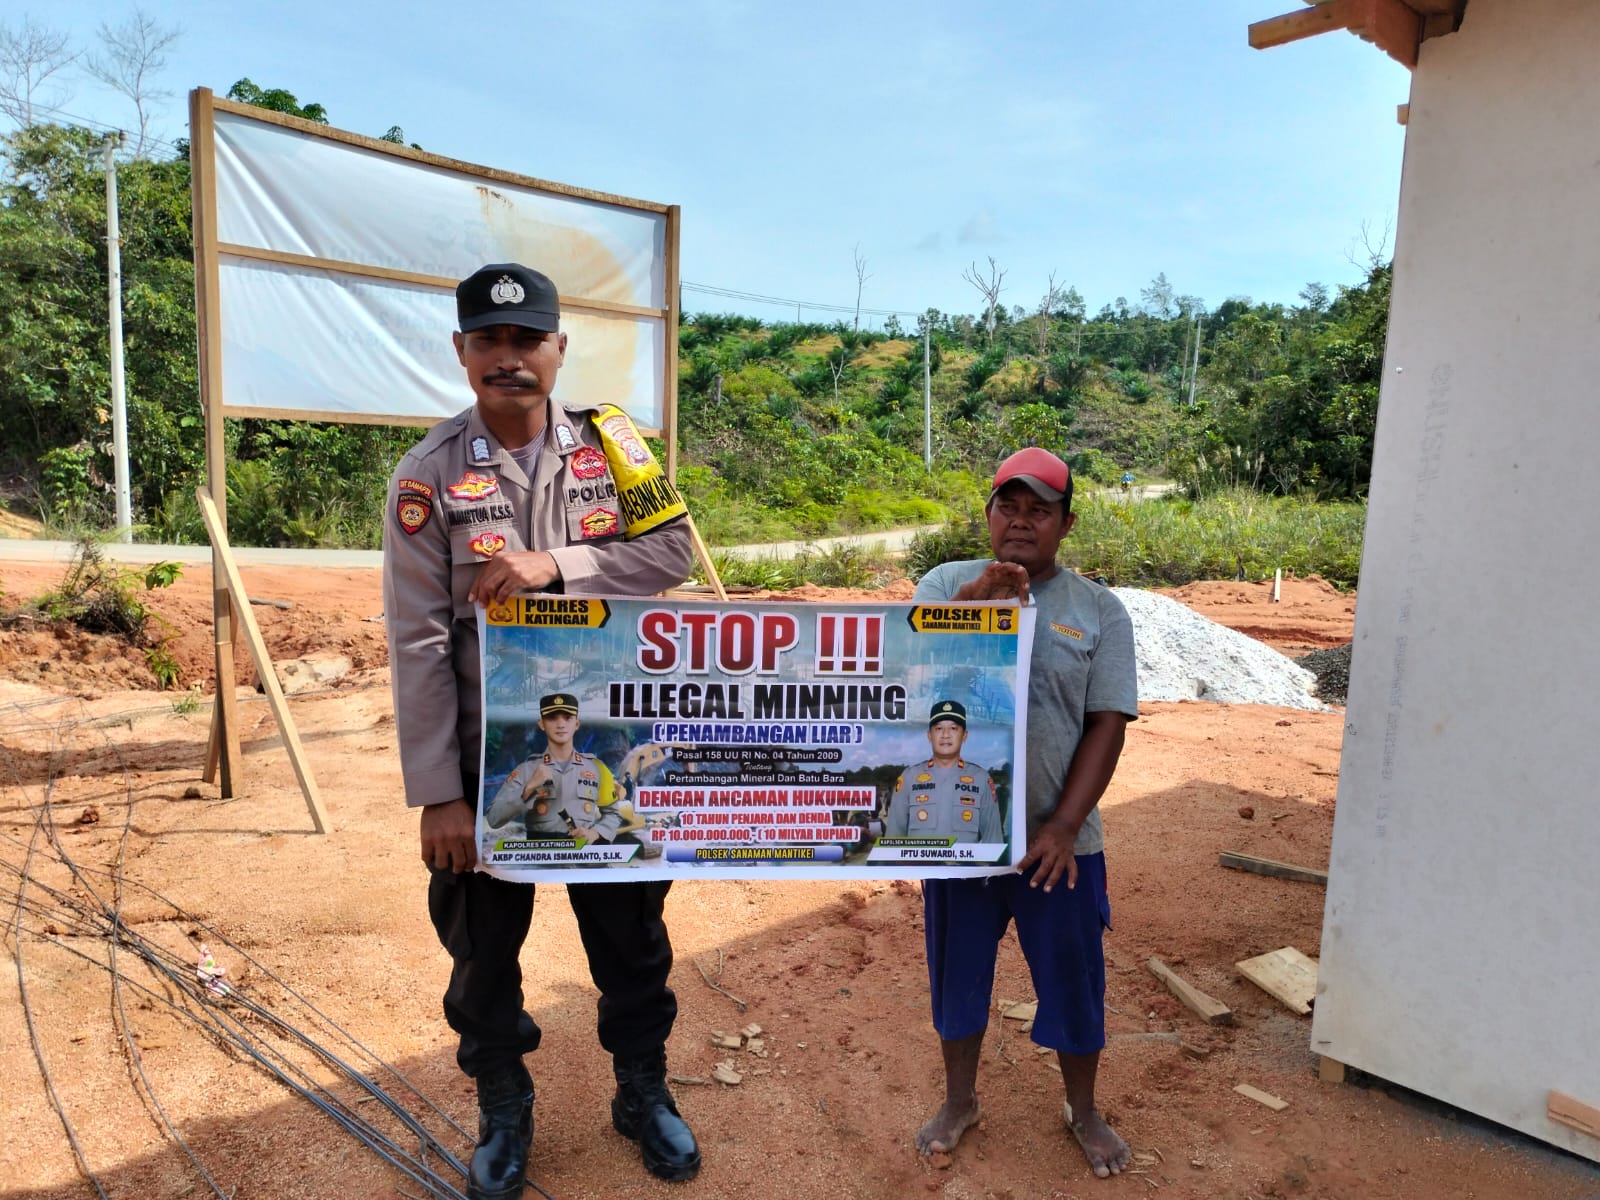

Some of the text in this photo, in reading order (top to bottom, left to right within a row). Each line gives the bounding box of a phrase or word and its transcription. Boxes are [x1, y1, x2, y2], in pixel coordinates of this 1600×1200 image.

[524, 599, 589, 613] POLRES
[524, 613, 589, 625] KATINGAN
[921, 608, 982, 621] POLSEK
[638, 609, 885, 675] STOP !!!
[608, 683, 907, 720] ILLEGAL MINNING
[676, 750, 839, 760] Pasal 158 UU RI No. 04 Tahun 2009
[669, 773, 844, 785] Pertambangan Mineral Dan Batu Bara
[954, 783, 980, 794] POLRI
[639, 790, 872, 807] DENGAN ANCAMAN HUKUMAN
[682, 813, 831, 825] 10 TAHUN PENJARA DAN DENDA
[651, 830, 667, 842] RP.
[778, 829, 813, 841] MILYAR
[503, 841, 539, 849] KAPOLRES
[492, 853, 513, 862] AKBP
[514, 853, 552, 861] CHANDRA
[553, 852, 601, 862] ISMAWANTO,
[696, 848, 815, 859] POLSEK SANAMAN MANTIKEI
[900, 849, 975, 859] IPTU SUWARDI, S.H.
